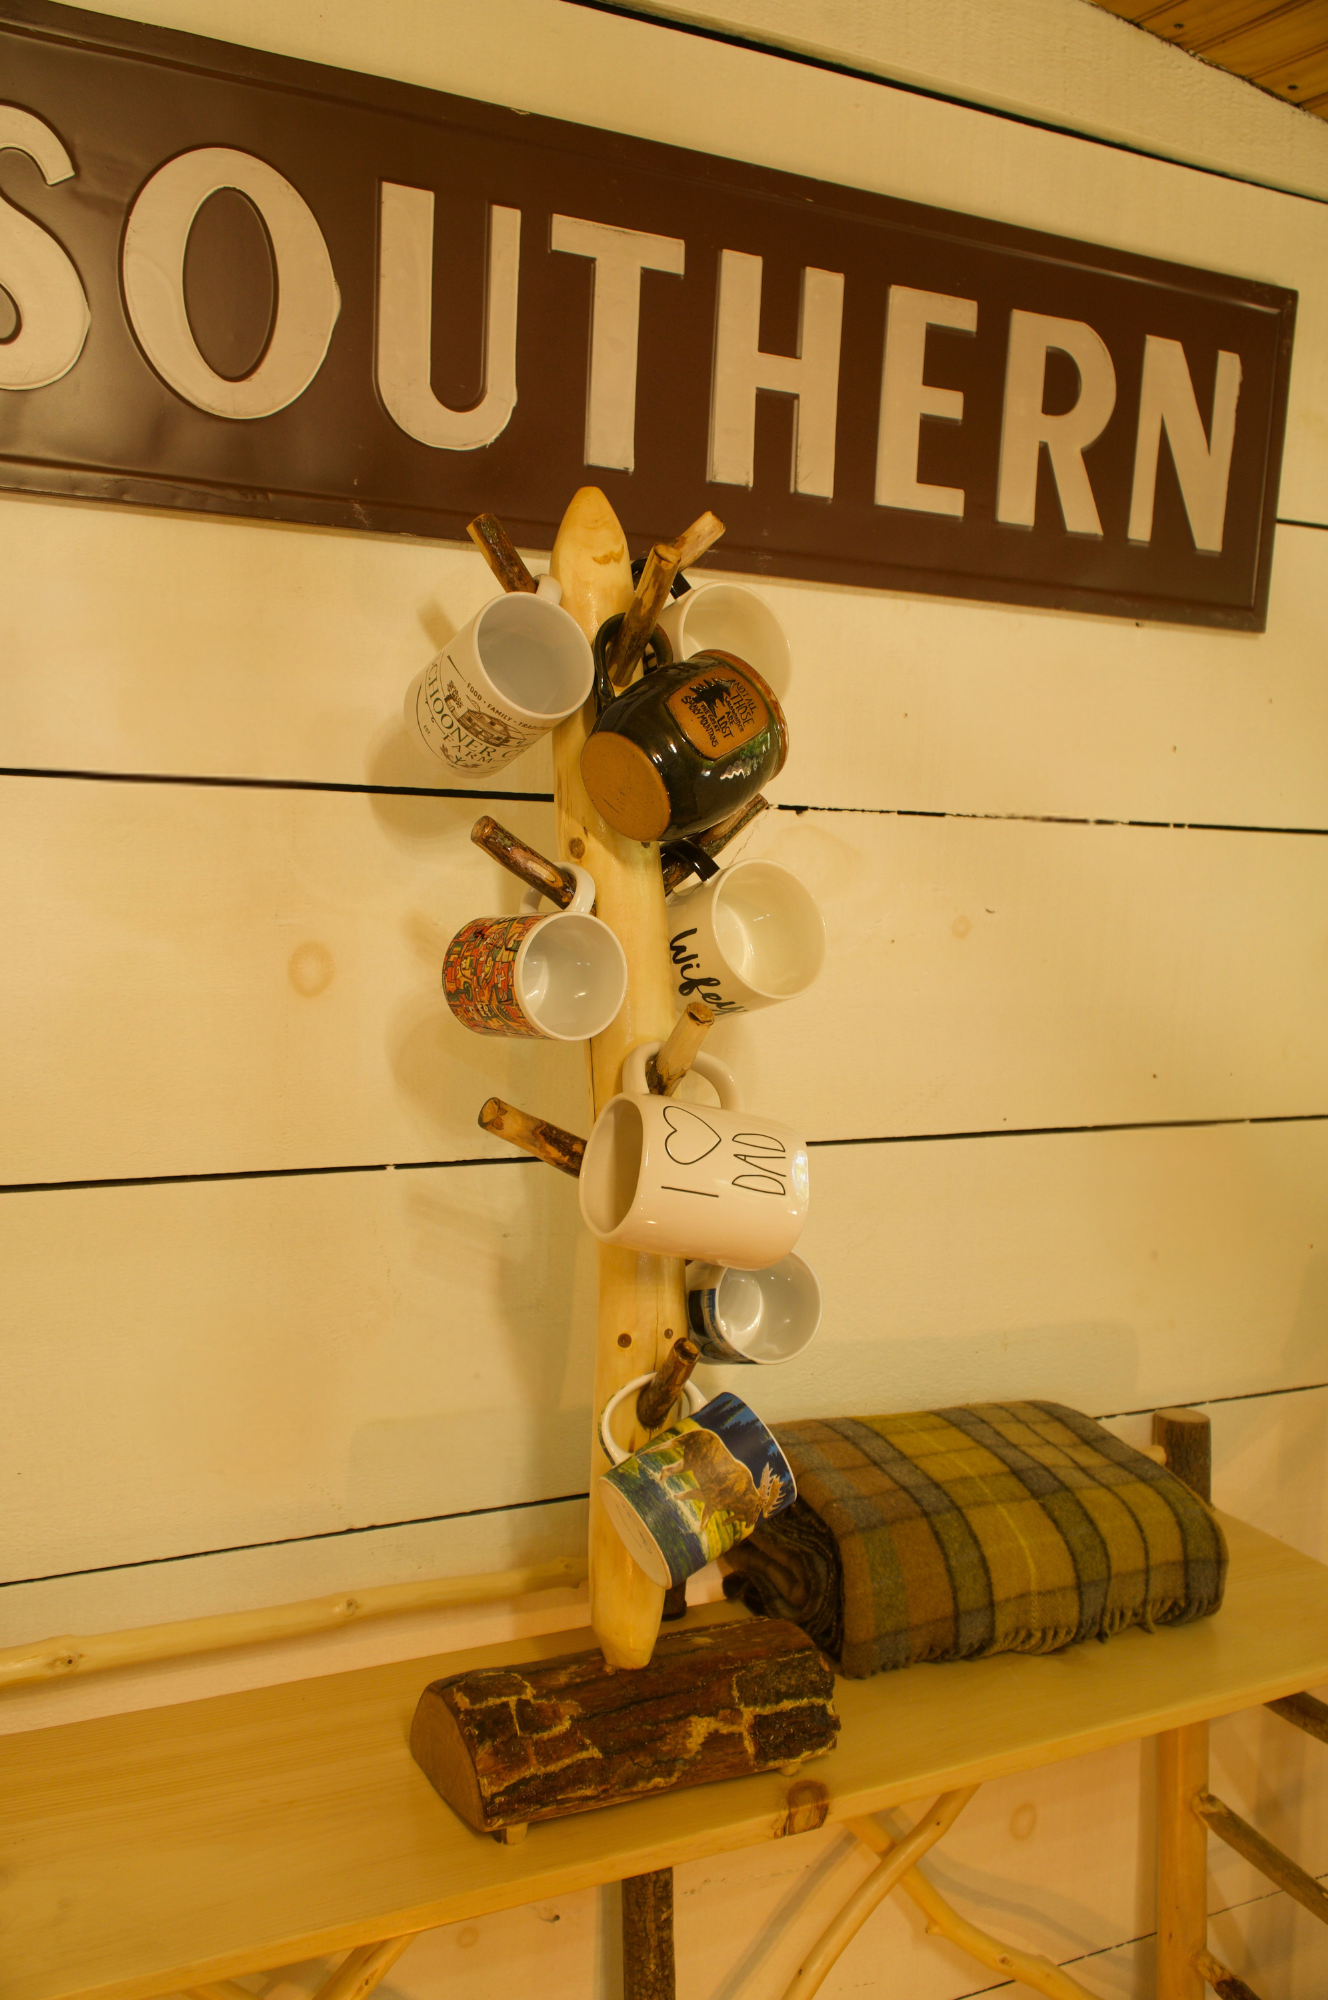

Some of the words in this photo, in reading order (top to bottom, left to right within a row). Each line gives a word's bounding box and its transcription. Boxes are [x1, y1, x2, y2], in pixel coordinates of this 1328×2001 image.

[0, 103, 1243, 558] SOUTHERN
[466, 682, 482, 701] FOOD
[487, 703, 512, 721] FAMILY
[730, 690, 754, 726] THOSE
[735, 683, 749, 699] NOT
[745, 697, 757, 714] ALL
[700, 703, 709, 714] THE
[707, 714, 720, 733] GREAT
[716, 715, 734, 738] LOST
[725, 711, 733, 725] ARE
[442, 733, 493, 765] FARM
[732, 1132, 787, 1196] DAD
